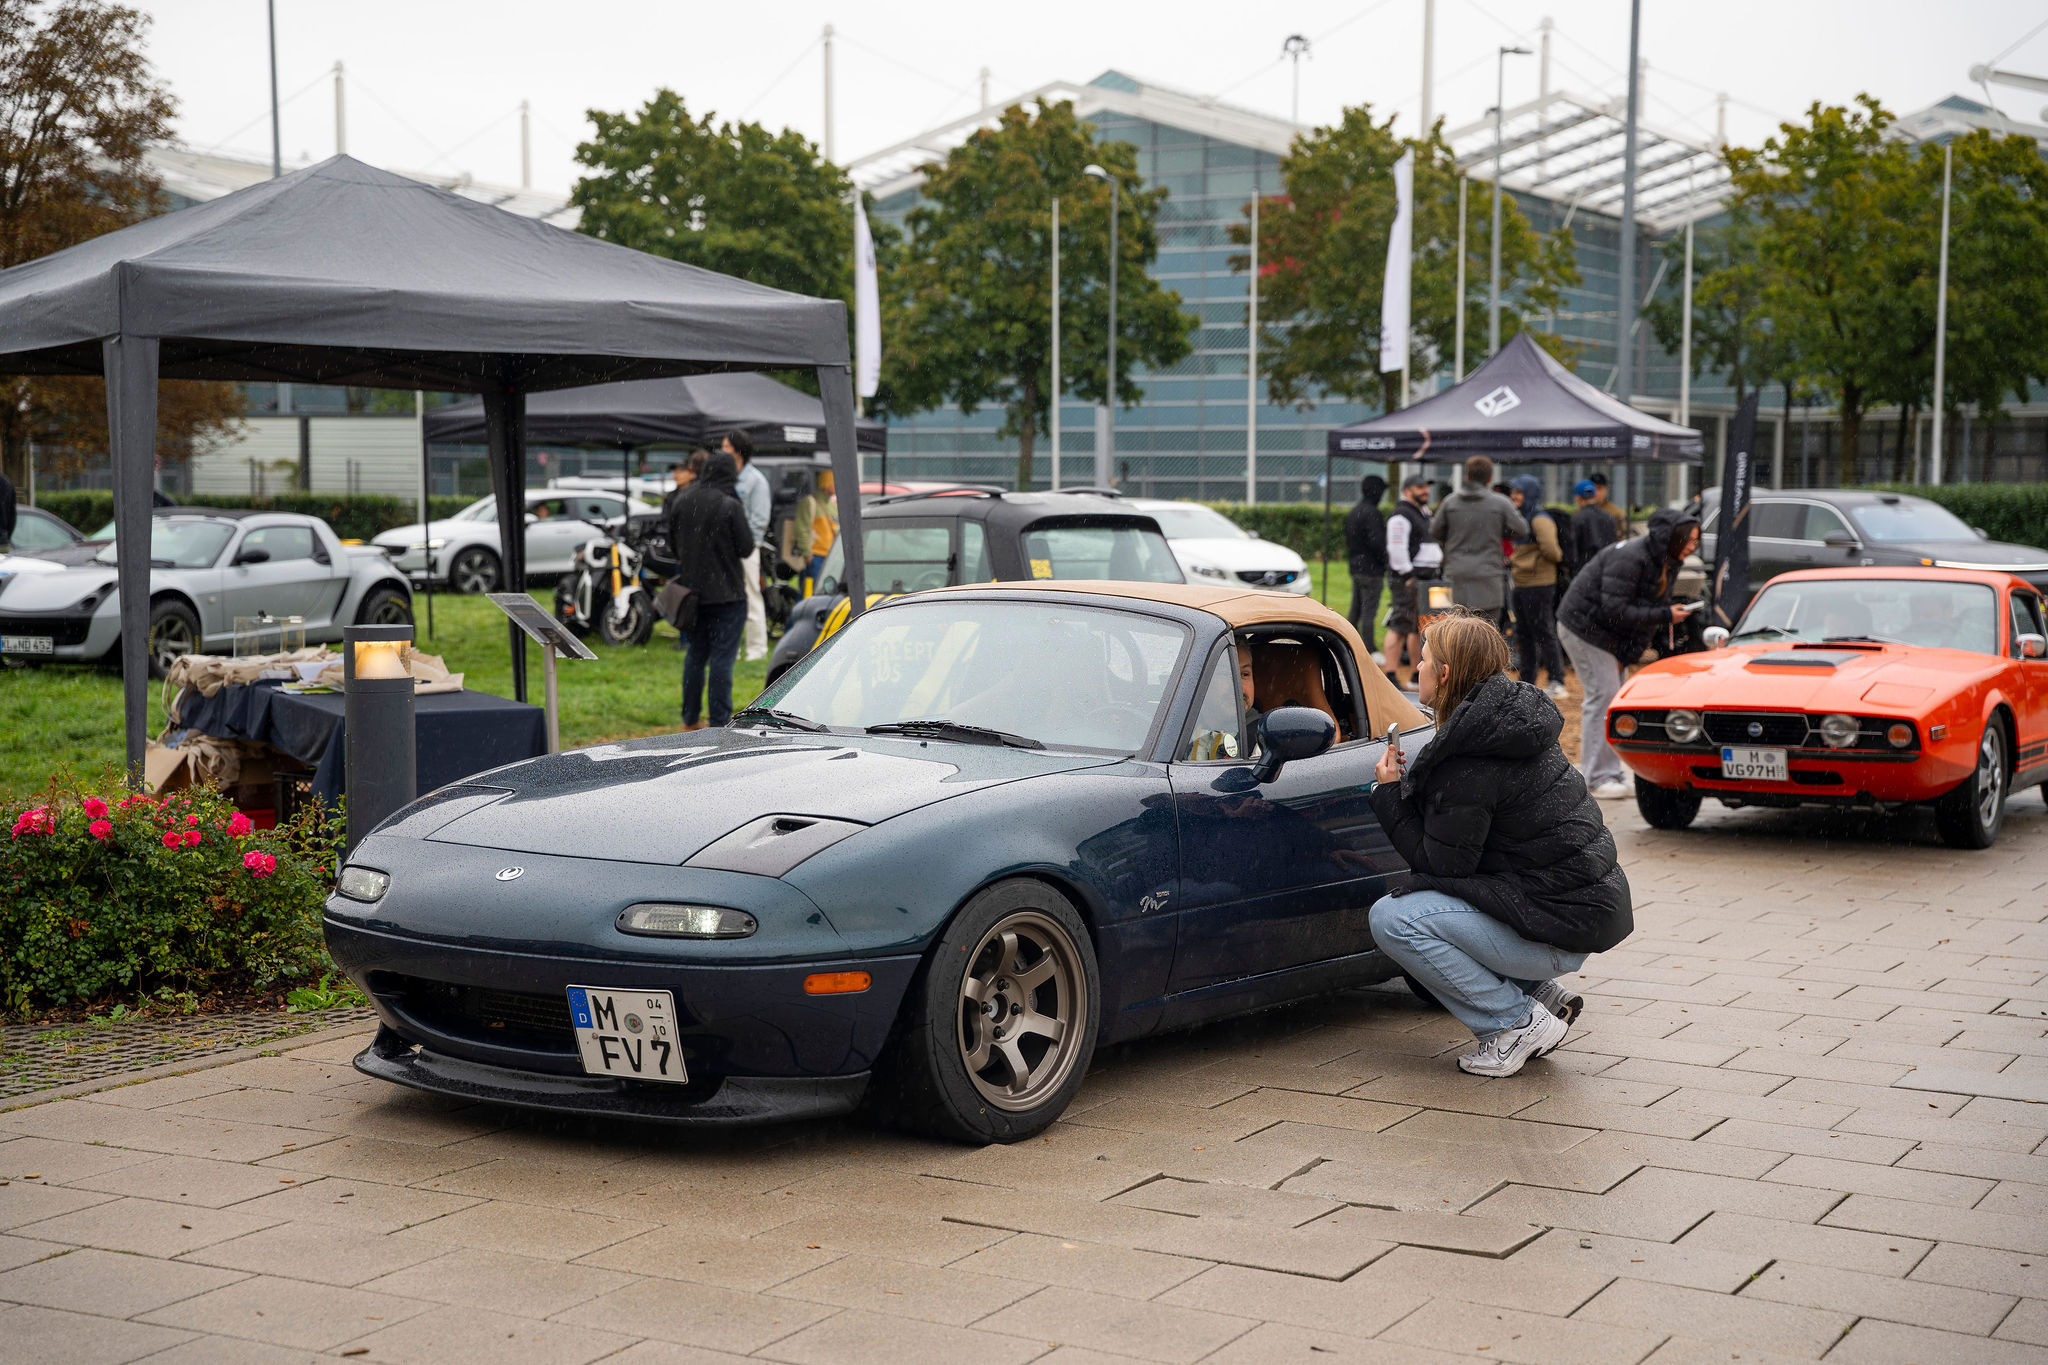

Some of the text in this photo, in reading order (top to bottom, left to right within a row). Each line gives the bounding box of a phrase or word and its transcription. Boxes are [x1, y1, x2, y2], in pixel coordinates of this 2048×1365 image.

[1572, 436, 1591, 448] THE
[1750, 752, 1759, 763] M
[646, 998, 662, 1009] 04
[578, 1012, 588, 1024] D
[592, 995, 619, 1031] M
[653, 1025, 666, 1036] 10
